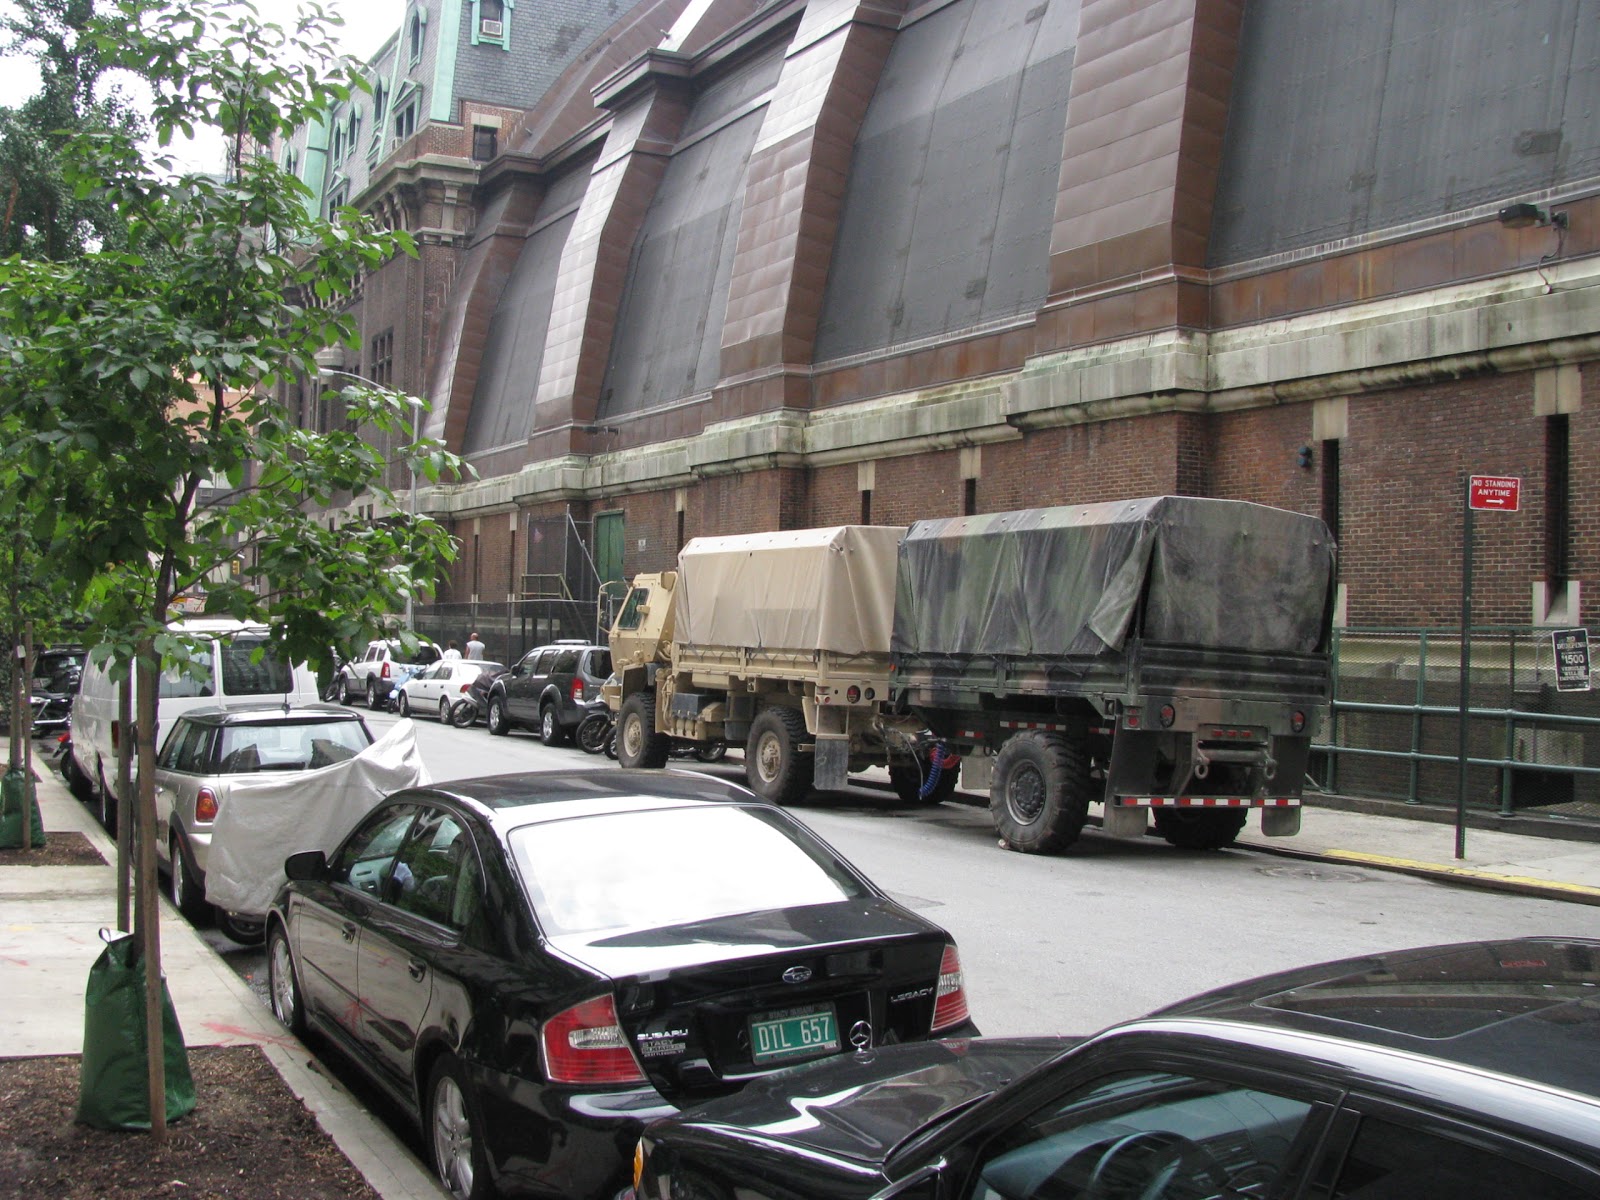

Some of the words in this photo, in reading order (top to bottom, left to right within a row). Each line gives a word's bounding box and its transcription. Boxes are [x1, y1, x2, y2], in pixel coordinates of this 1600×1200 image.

[1485, 480, 1516, 488] STANDING
[1478, 489, 1511, 497] ANYTIME
[890, 987, 934, 1003] LEGACY
[637, 1029, 689, 1041] SUBARU
[758, 1023, 792, 1051] DTL
[800, 1017, 830, 1044] 657
[642, 1039, 674, 1048] STACY
